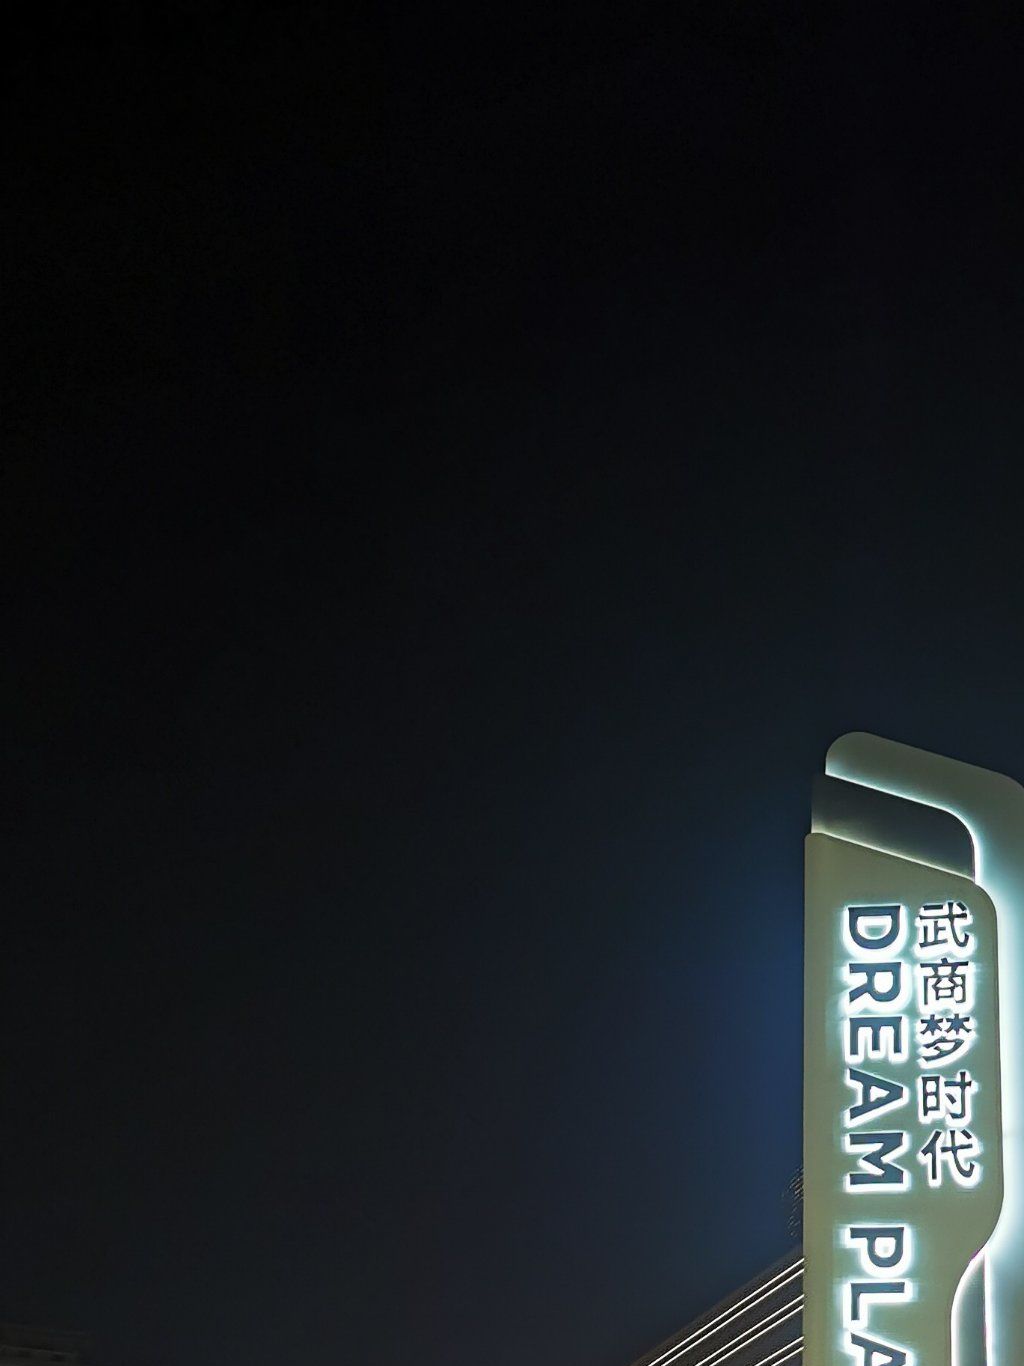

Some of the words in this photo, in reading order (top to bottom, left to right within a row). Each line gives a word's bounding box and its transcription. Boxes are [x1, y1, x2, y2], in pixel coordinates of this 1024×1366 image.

[847, 904, 905, 1186] DREAM
[918, 901, 976, 1180] 武商梦时代
